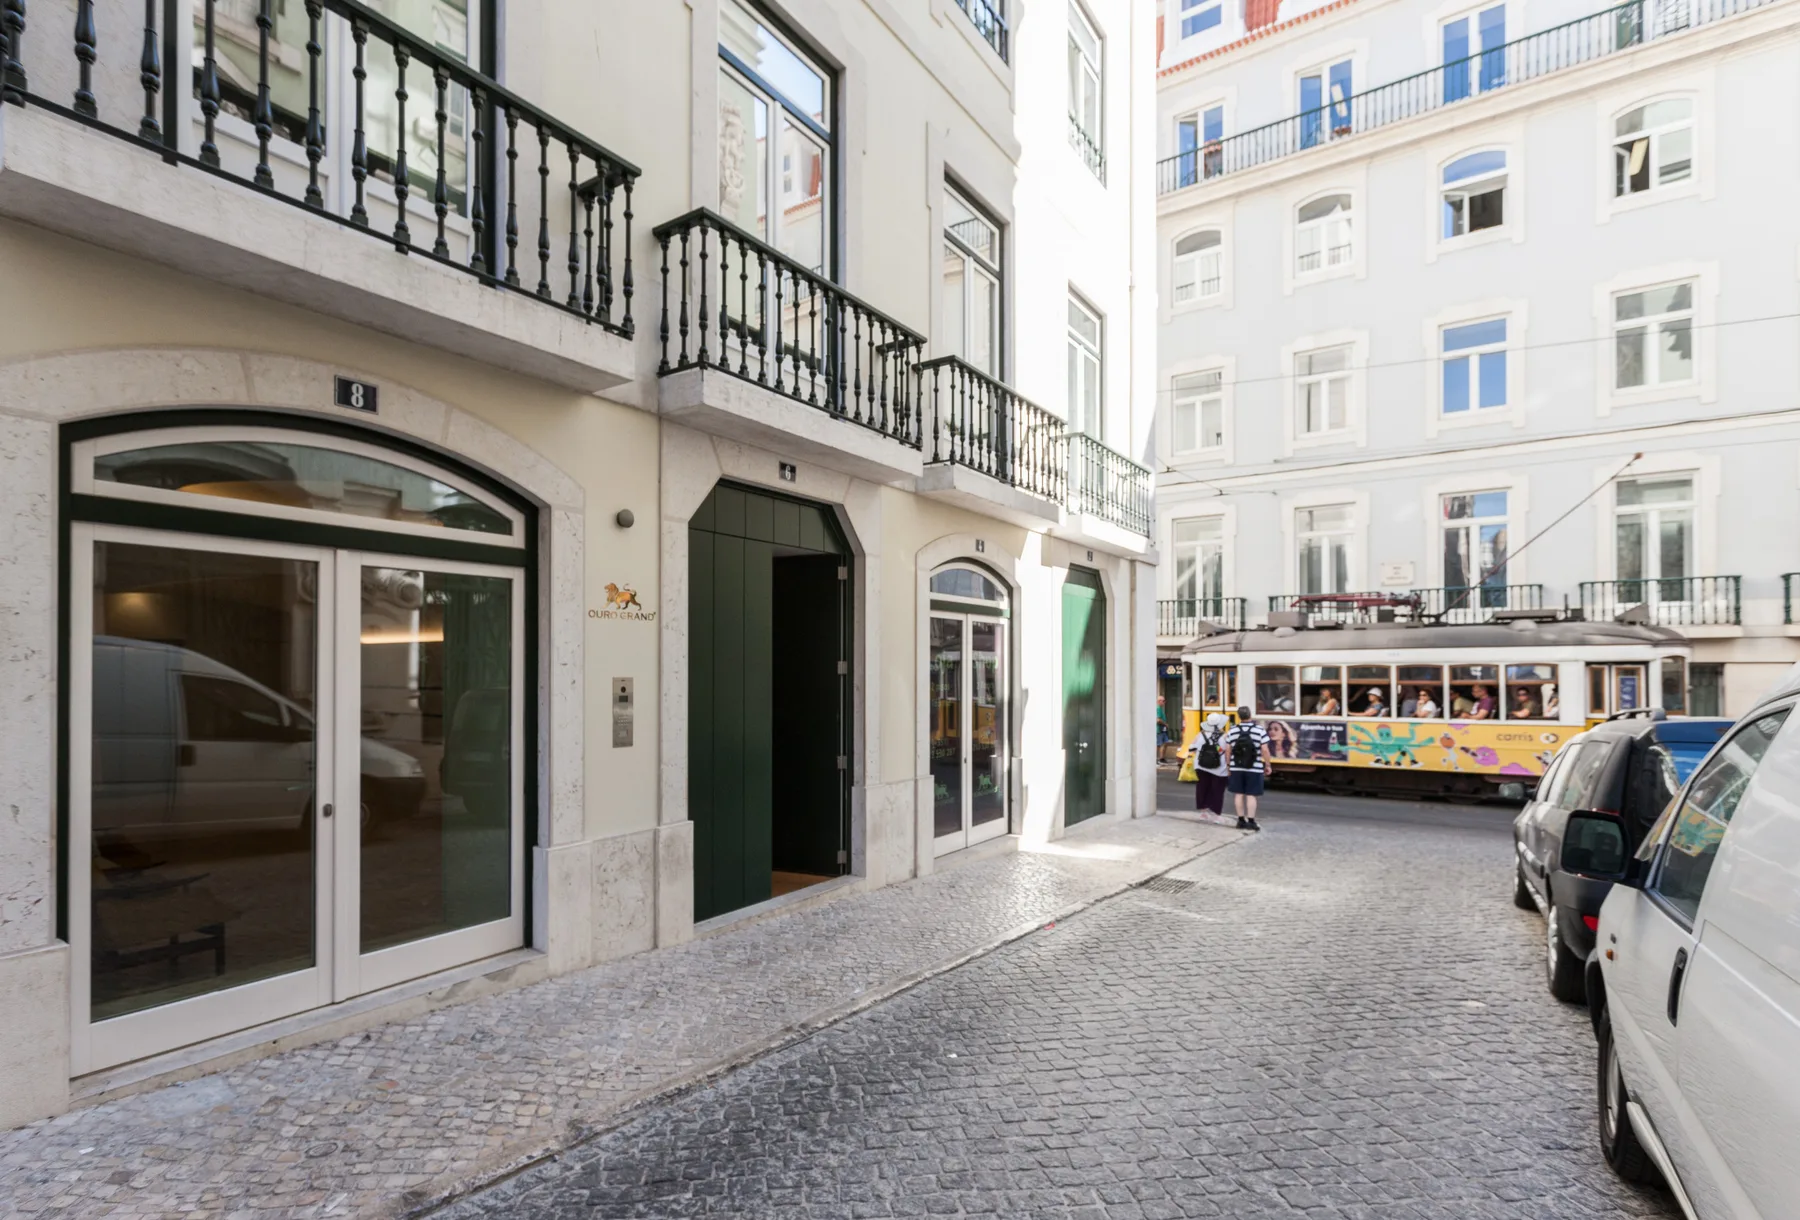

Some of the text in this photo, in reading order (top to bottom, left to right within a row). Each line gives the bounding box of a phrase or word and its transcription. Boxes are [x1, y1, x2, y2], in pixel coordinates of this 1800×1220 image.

[350, 382, 364, 408] 8
[785, 465, 791, 480] 6
[588, 609, 655, 622] OURO GRAND
[1496, 731, 1534, 742] carris
